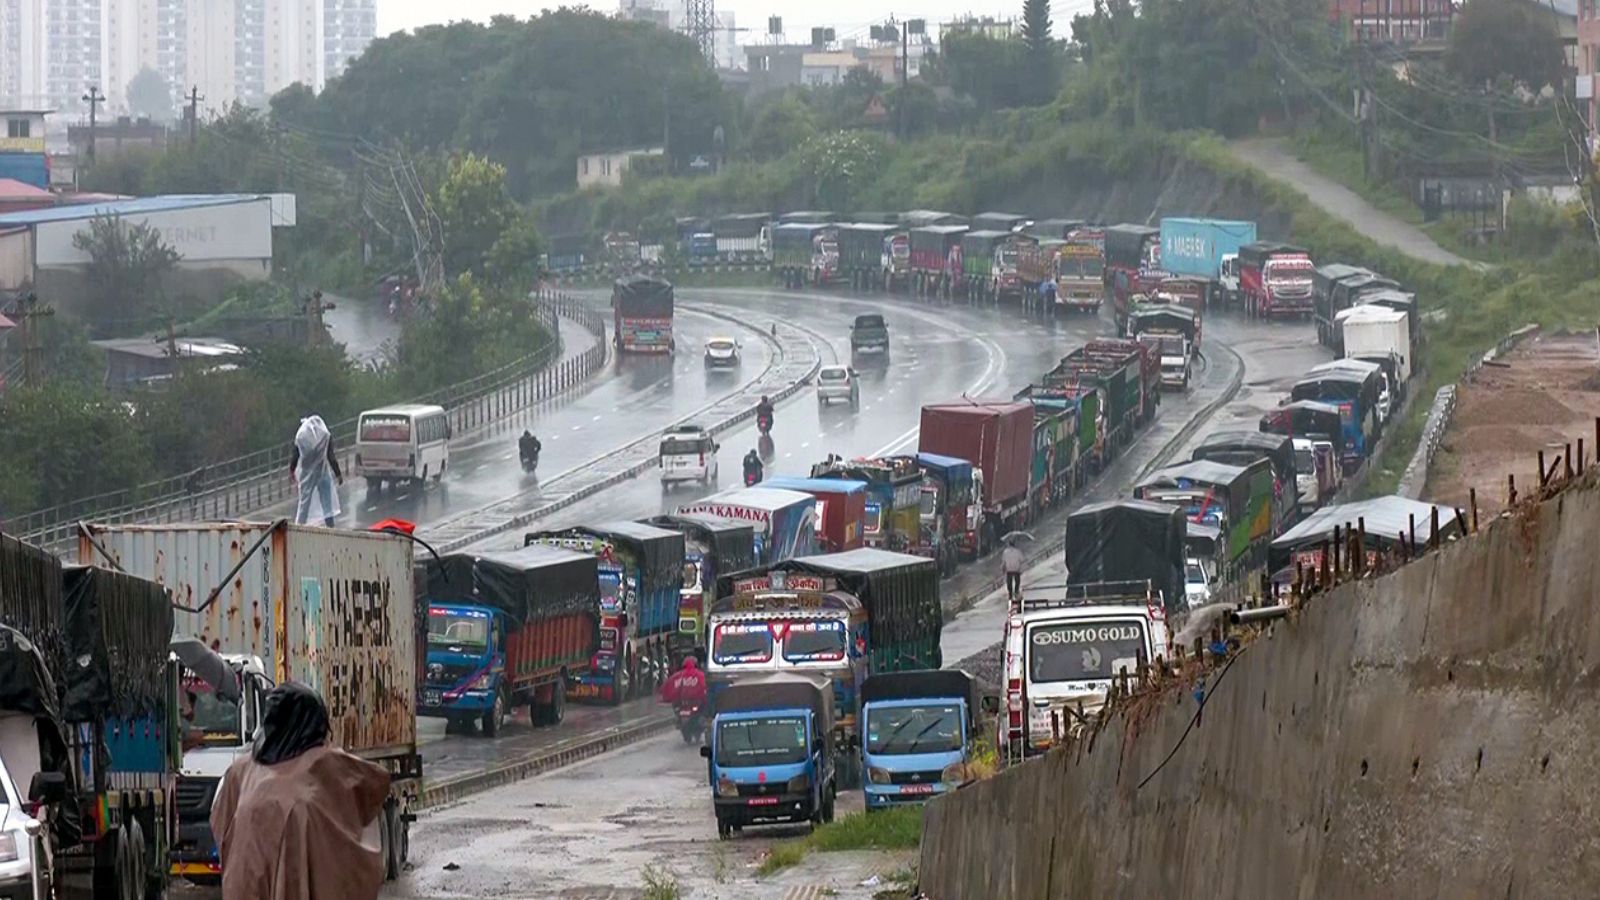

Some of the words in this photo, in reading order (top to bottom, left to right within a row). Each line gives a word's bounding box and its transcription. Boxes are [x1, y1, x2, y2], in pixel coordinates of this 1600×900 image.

[160, 226, 216, 243] ERNET
[1052, 629, 1096, 643] SUMO
[1098, 626, 1140, 639] GOLD
